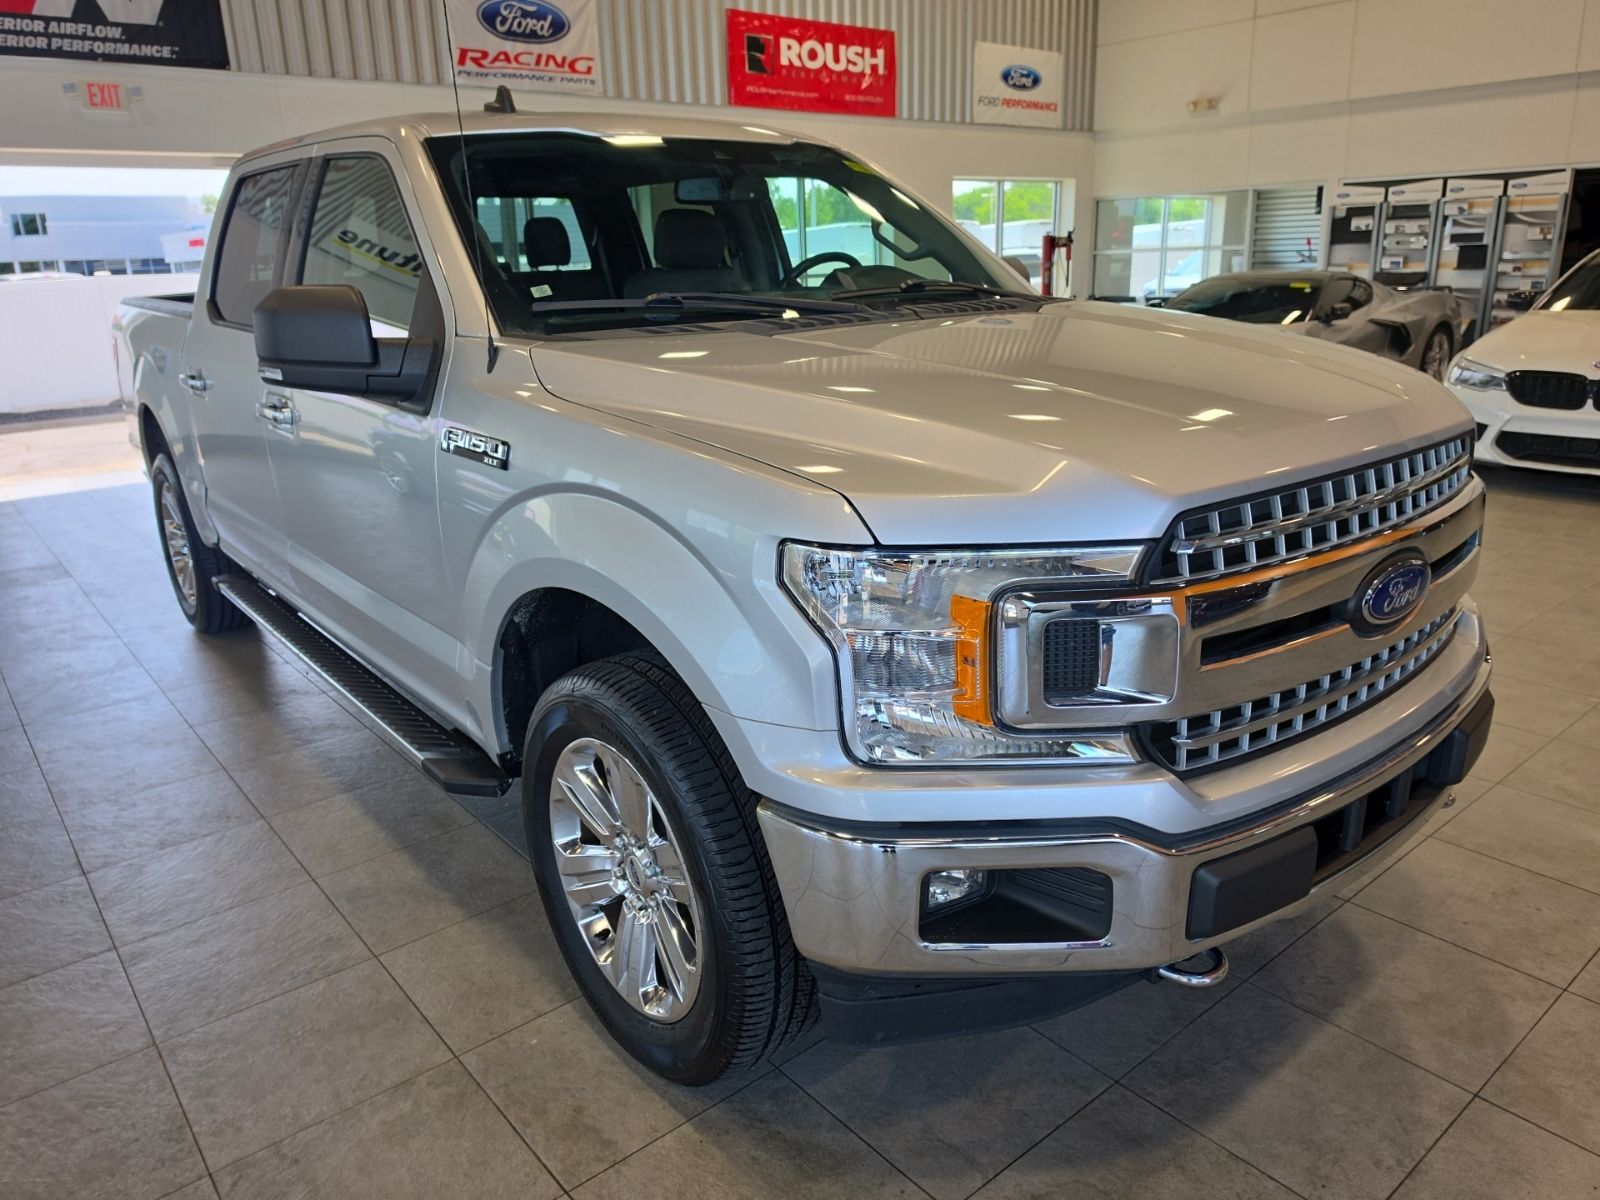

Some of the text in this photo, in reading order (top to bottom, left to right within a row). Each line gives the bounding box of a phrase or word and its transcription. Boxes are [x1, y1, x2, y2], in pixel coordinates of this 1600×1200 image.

[48, 21, 125, 39] AIRFLOW.
[495, 1, 553, 37] Ford
[457, 47, 595, 75] RACING
[779, 37, 885, 75] ROUSH
[457, 70, 596, 85] PERFORMANCE PARTS
[1008, 68, 1034, 87] Ford
[86, 82, 121, 109] EXIT
[1001, 98, 1058, 112] PERFORMANCE
[483, 456, 498, 466] XLT
[1383, 575, 1421, 613] Ford
